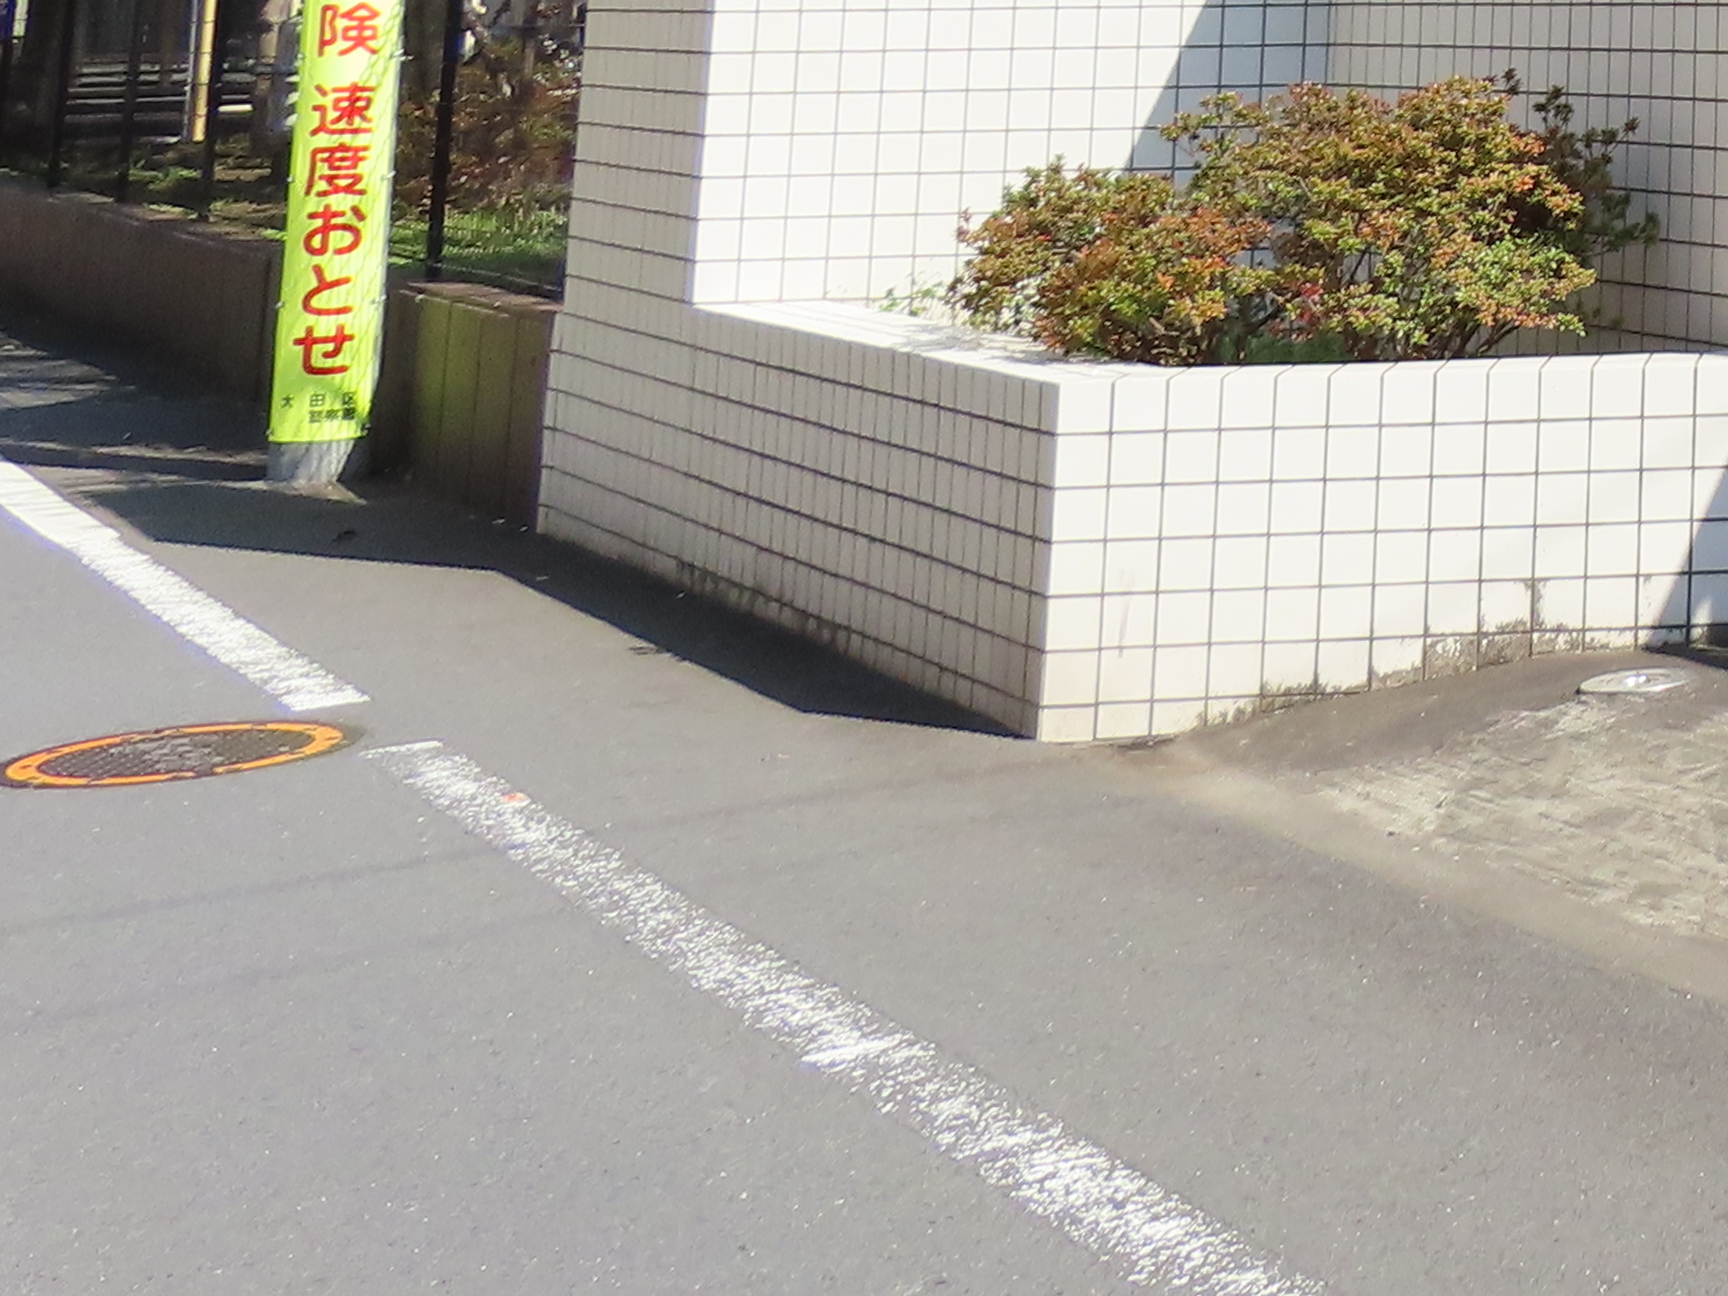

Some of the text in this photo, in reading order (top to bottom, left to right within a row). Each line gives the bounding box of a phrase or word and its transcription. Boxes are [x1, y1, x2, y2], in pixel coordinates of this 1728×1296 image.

[292, 83, 377, 376] 速度おとせ
